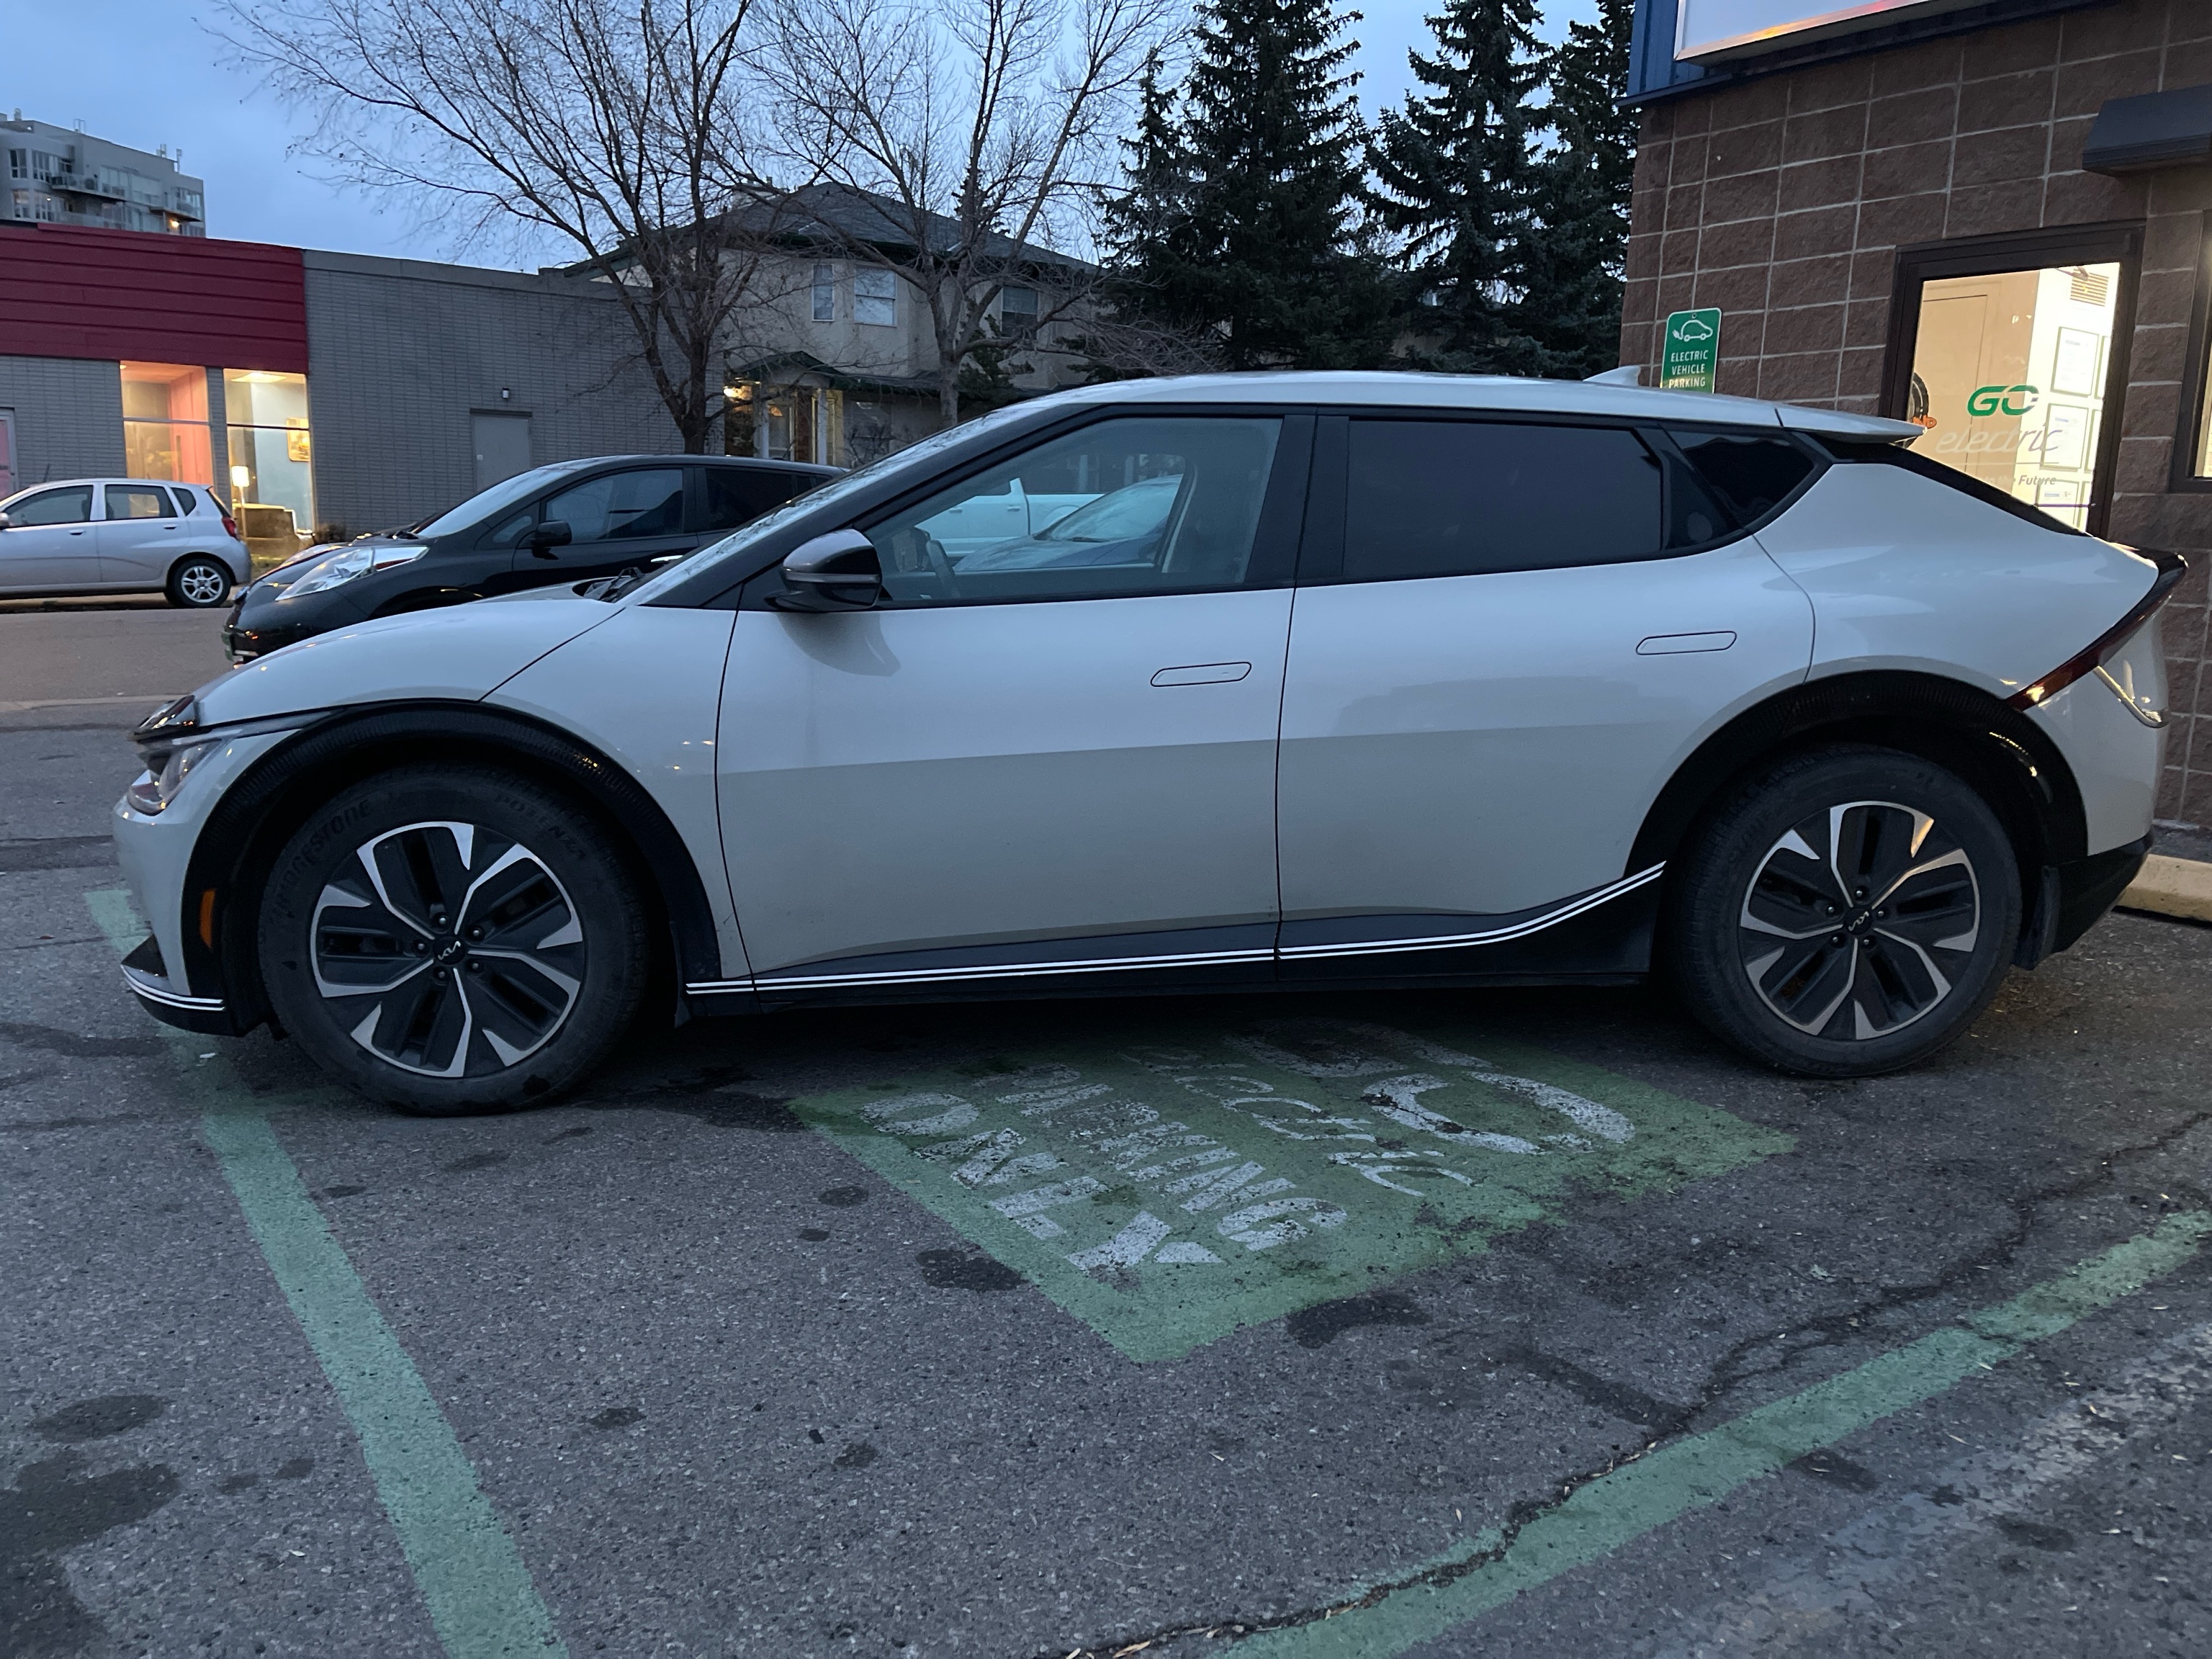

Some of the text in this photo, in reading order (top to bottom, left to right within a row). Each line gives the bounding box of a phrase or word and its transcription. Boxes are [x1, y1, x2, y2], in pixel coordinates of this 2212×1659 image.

[1671, 350, 1709, 362] ELECTRIC
[1671, 364, 1705, 375] VEHICLE
[1668, 377, 1706, 389] PARKING
[1967, 385, 2039, 417] GO
[1935, 421, 2063, 454] electric
[2018, 475, 2056, 485] Future
[972, 1064, 1348, 1251] PARKING
[860, 1092, 1224, 1279] ONLY
